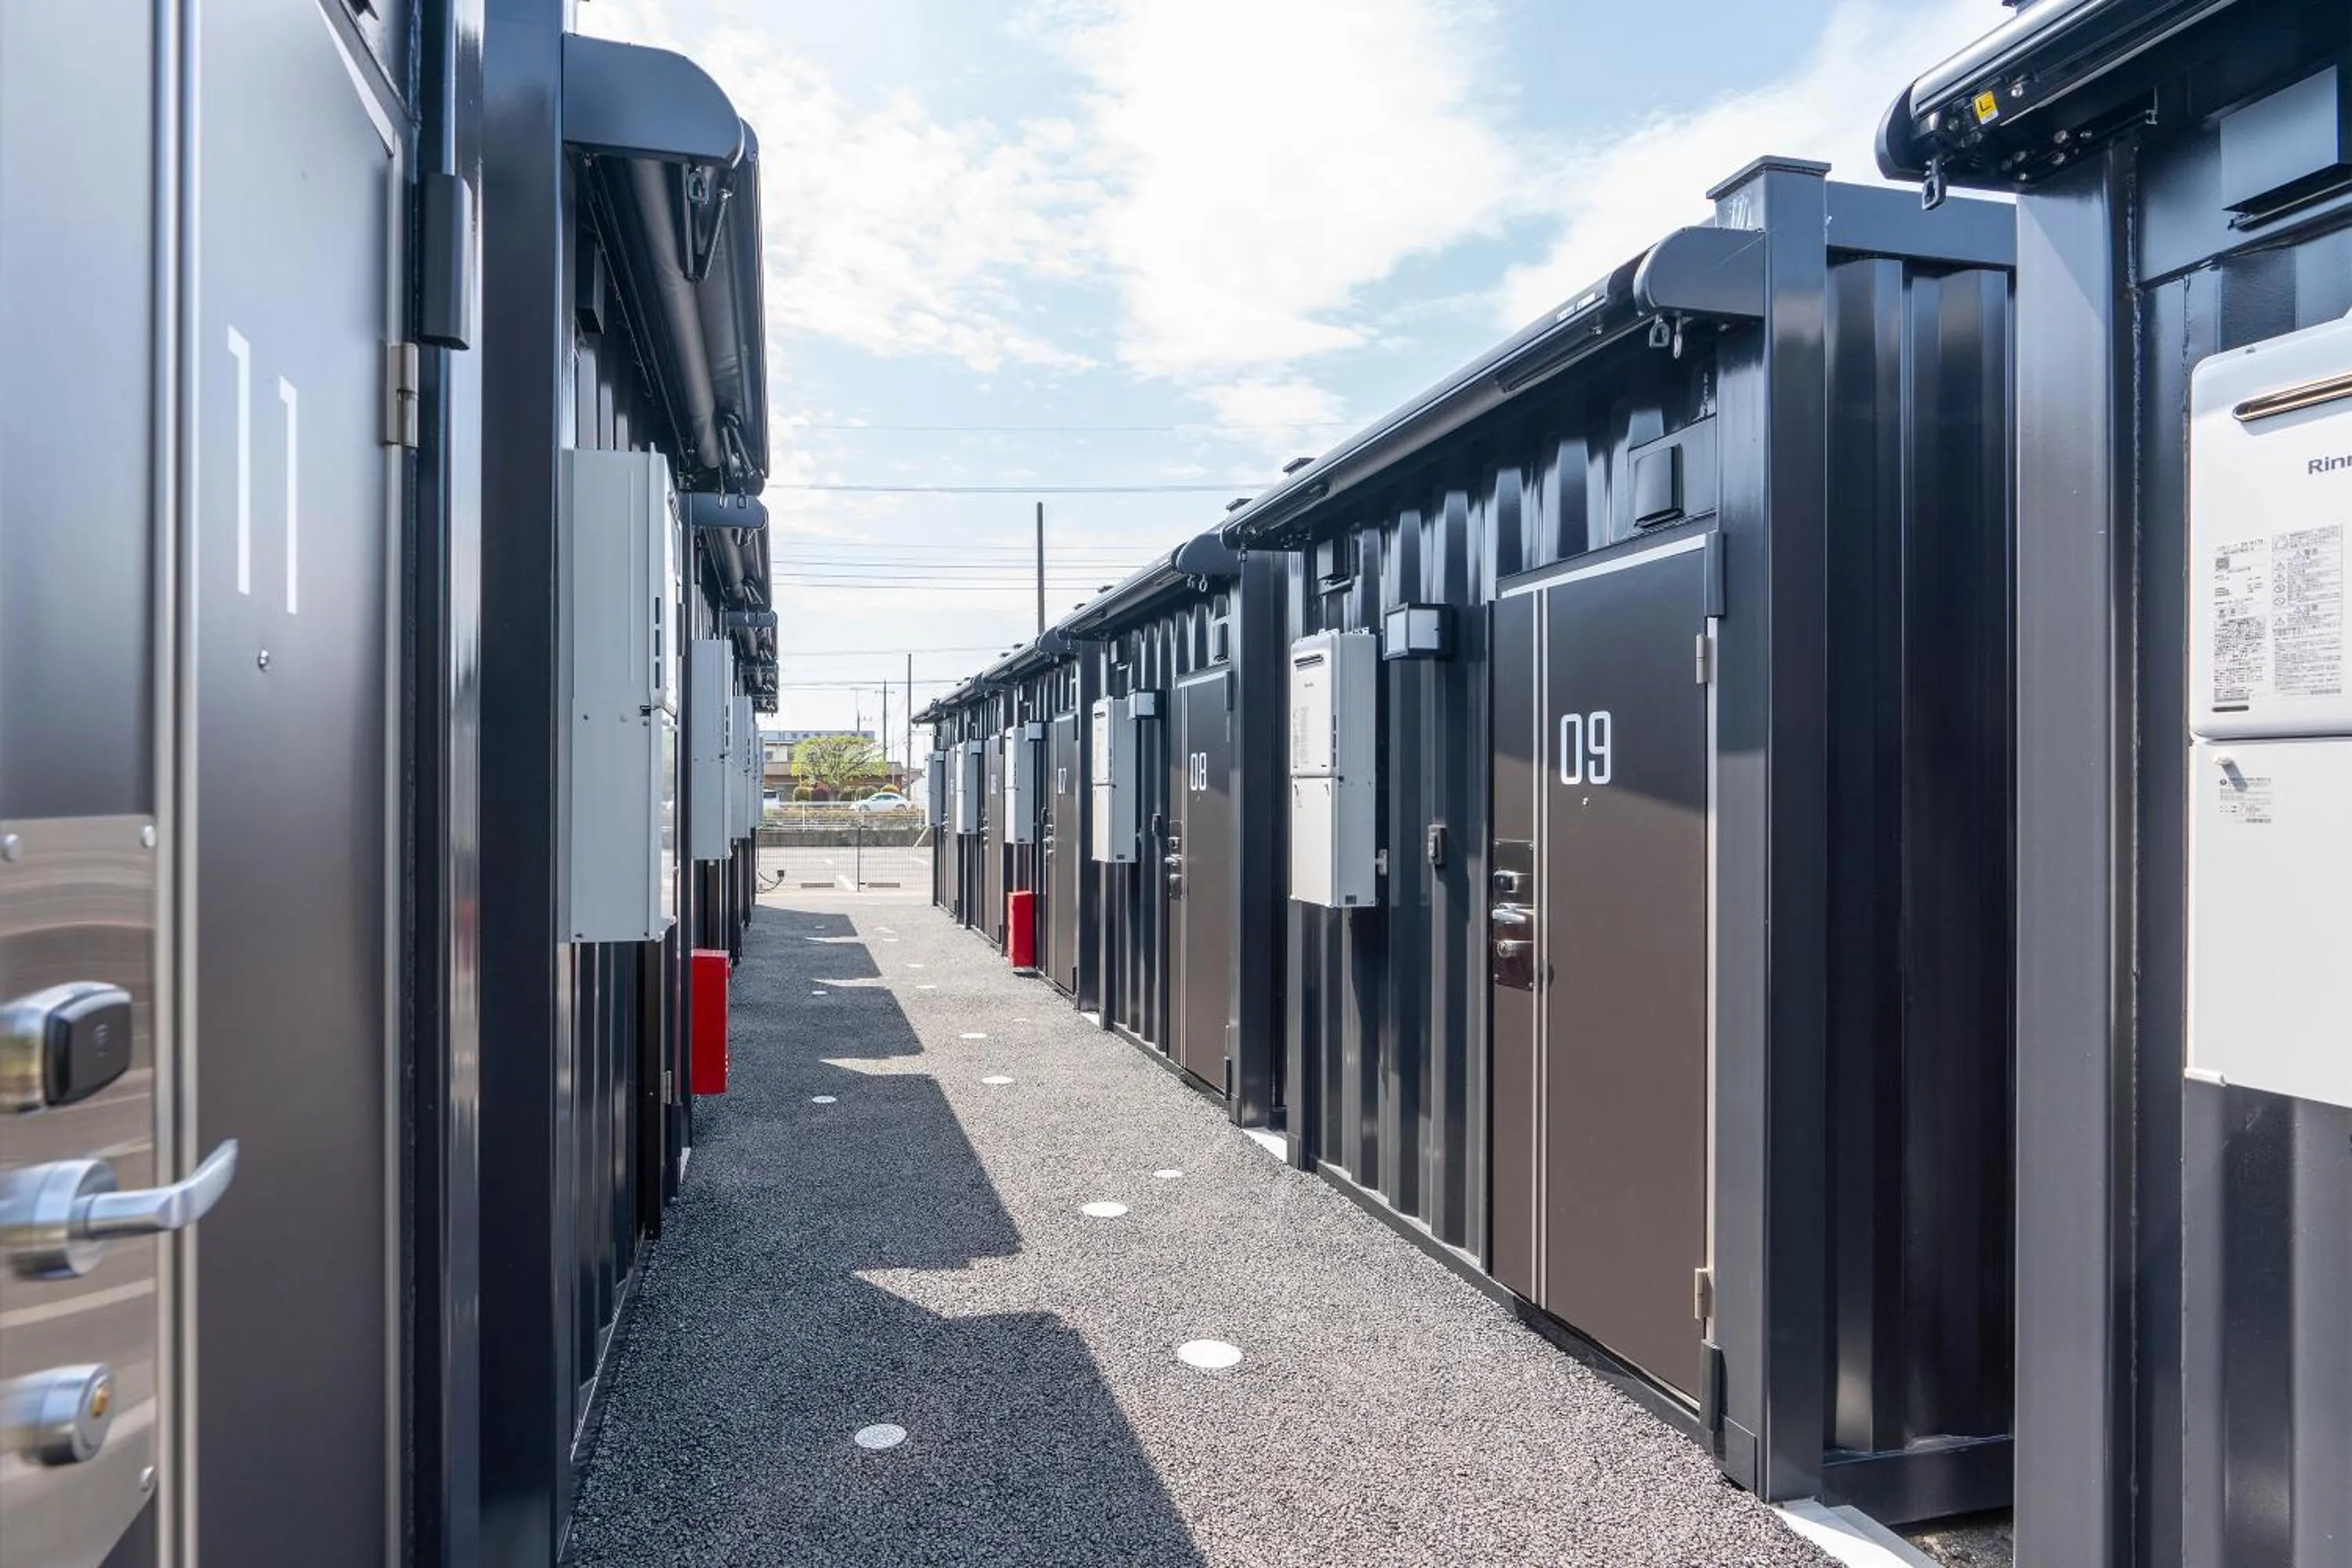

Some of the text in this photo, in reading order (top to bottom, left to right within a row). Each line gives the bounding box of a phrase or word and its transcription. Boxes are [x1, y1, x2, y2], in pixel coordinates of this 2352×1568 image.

[227, 325, 298, 615] 11
[1190, 752, 1207, 791] 08
[1560, 710, 1612, 786] 09
[1058, 768, 1067, 794] 07
